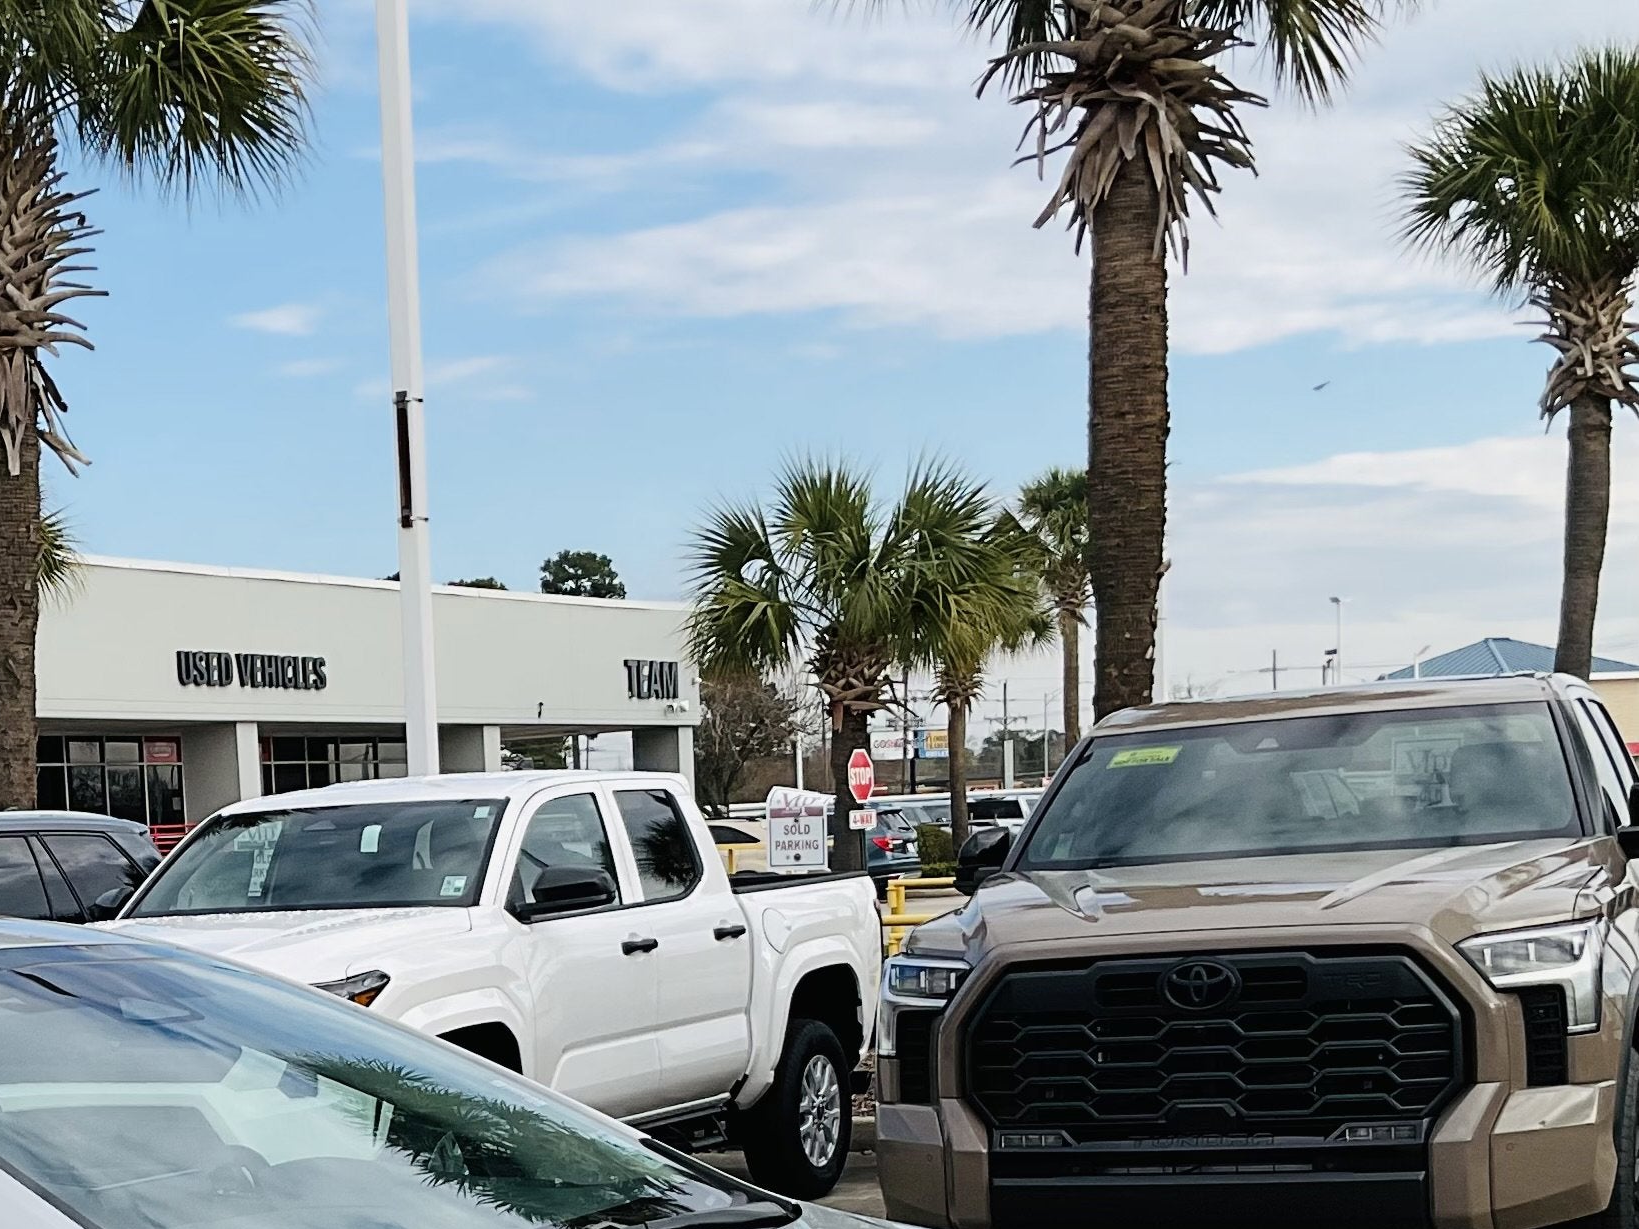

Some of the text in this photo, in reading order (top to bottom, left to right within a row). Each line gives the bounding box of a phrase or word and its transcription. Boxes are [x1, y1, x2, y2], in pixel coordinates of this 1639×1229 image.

[176, 651, 327, 690] USED VEHICLES
[624, 660, 678, 699] TEAM
[850, 767, 871, 786] STOP
[852, 813, 873, 825] 4-WAY
[783, 824, 811, 836] SOLD
[775, 839, 819, 851] PARKING
